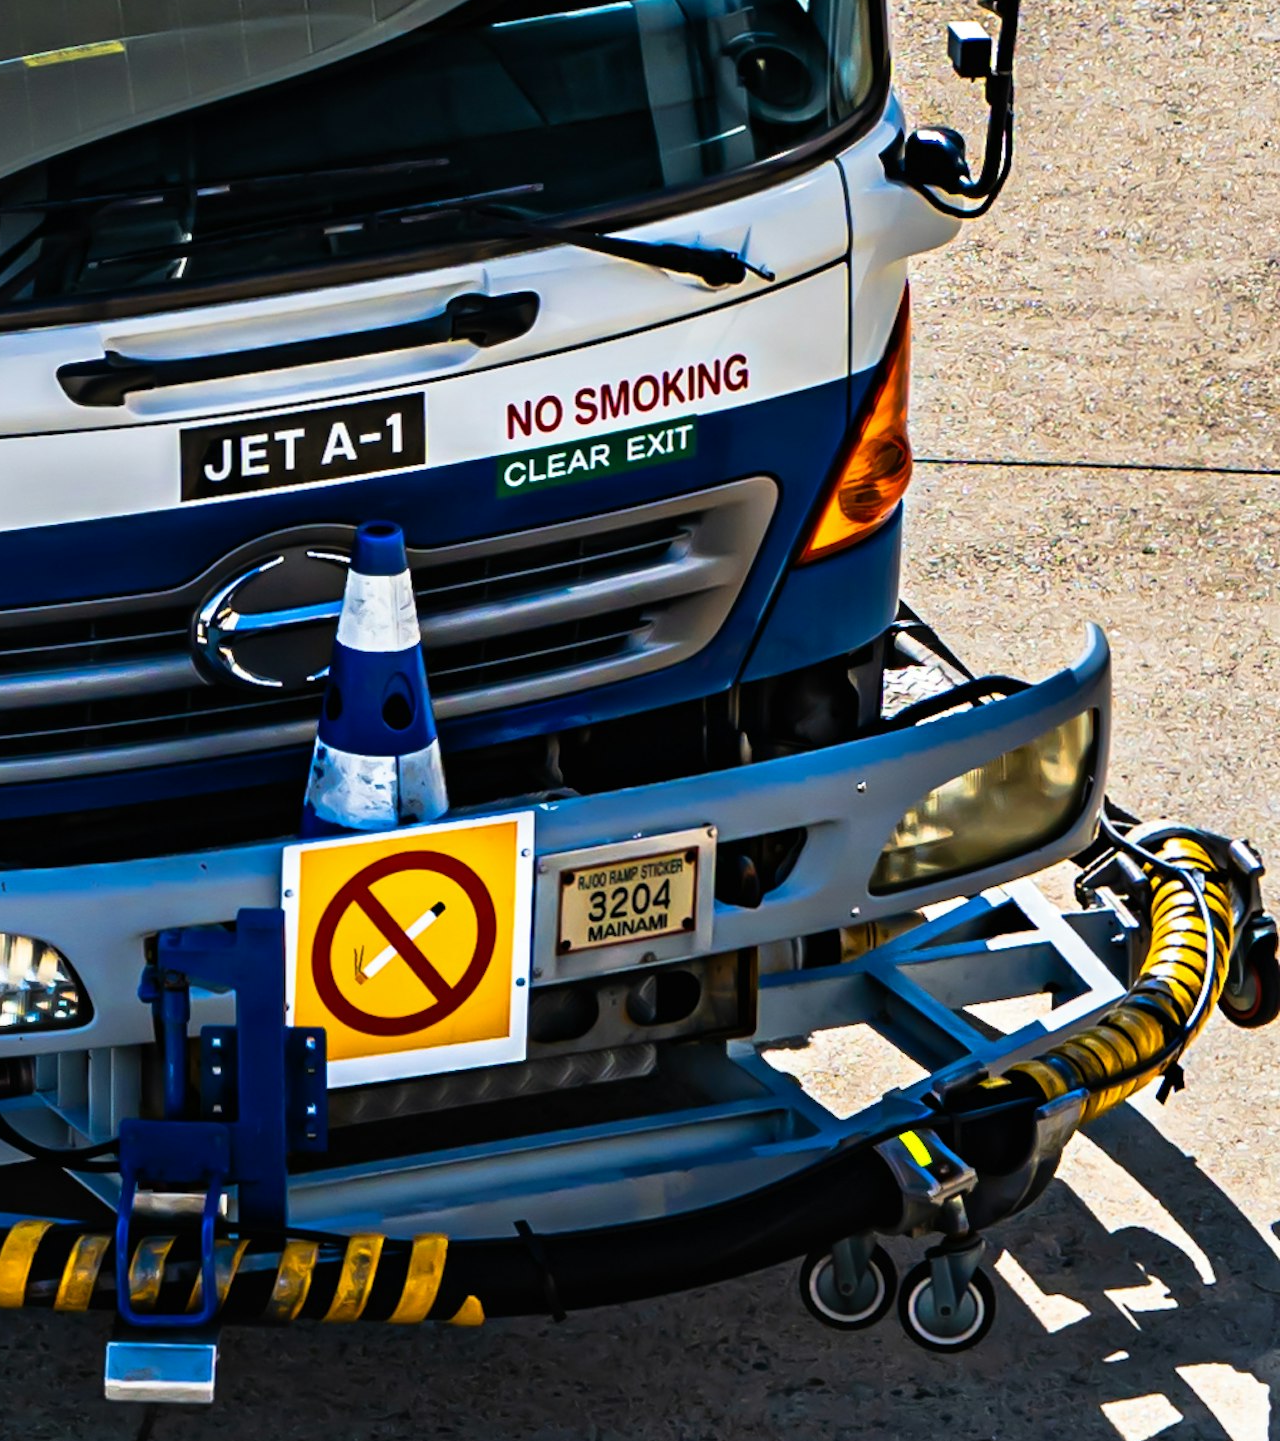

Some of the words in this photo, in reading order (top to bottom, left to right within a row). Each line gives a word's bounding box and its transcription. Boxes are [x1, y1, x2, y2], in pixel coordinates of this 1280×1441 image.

[506, 394, 563, 440] NO
[574, 353, 750, 425] SMOKING
[203, 427, 306, 482] JET
[320, 412, 404, 466] A-1
[503, 443, 611, 488] CLEAR
[626, 424, 694, 462] EXIT
[609, 866, 638, 885] RAMP
[640, 858, 684, 878] STICKER
[588, 878, 671, 922] 3204
[588, 913, 668, 942] MAINAMI
